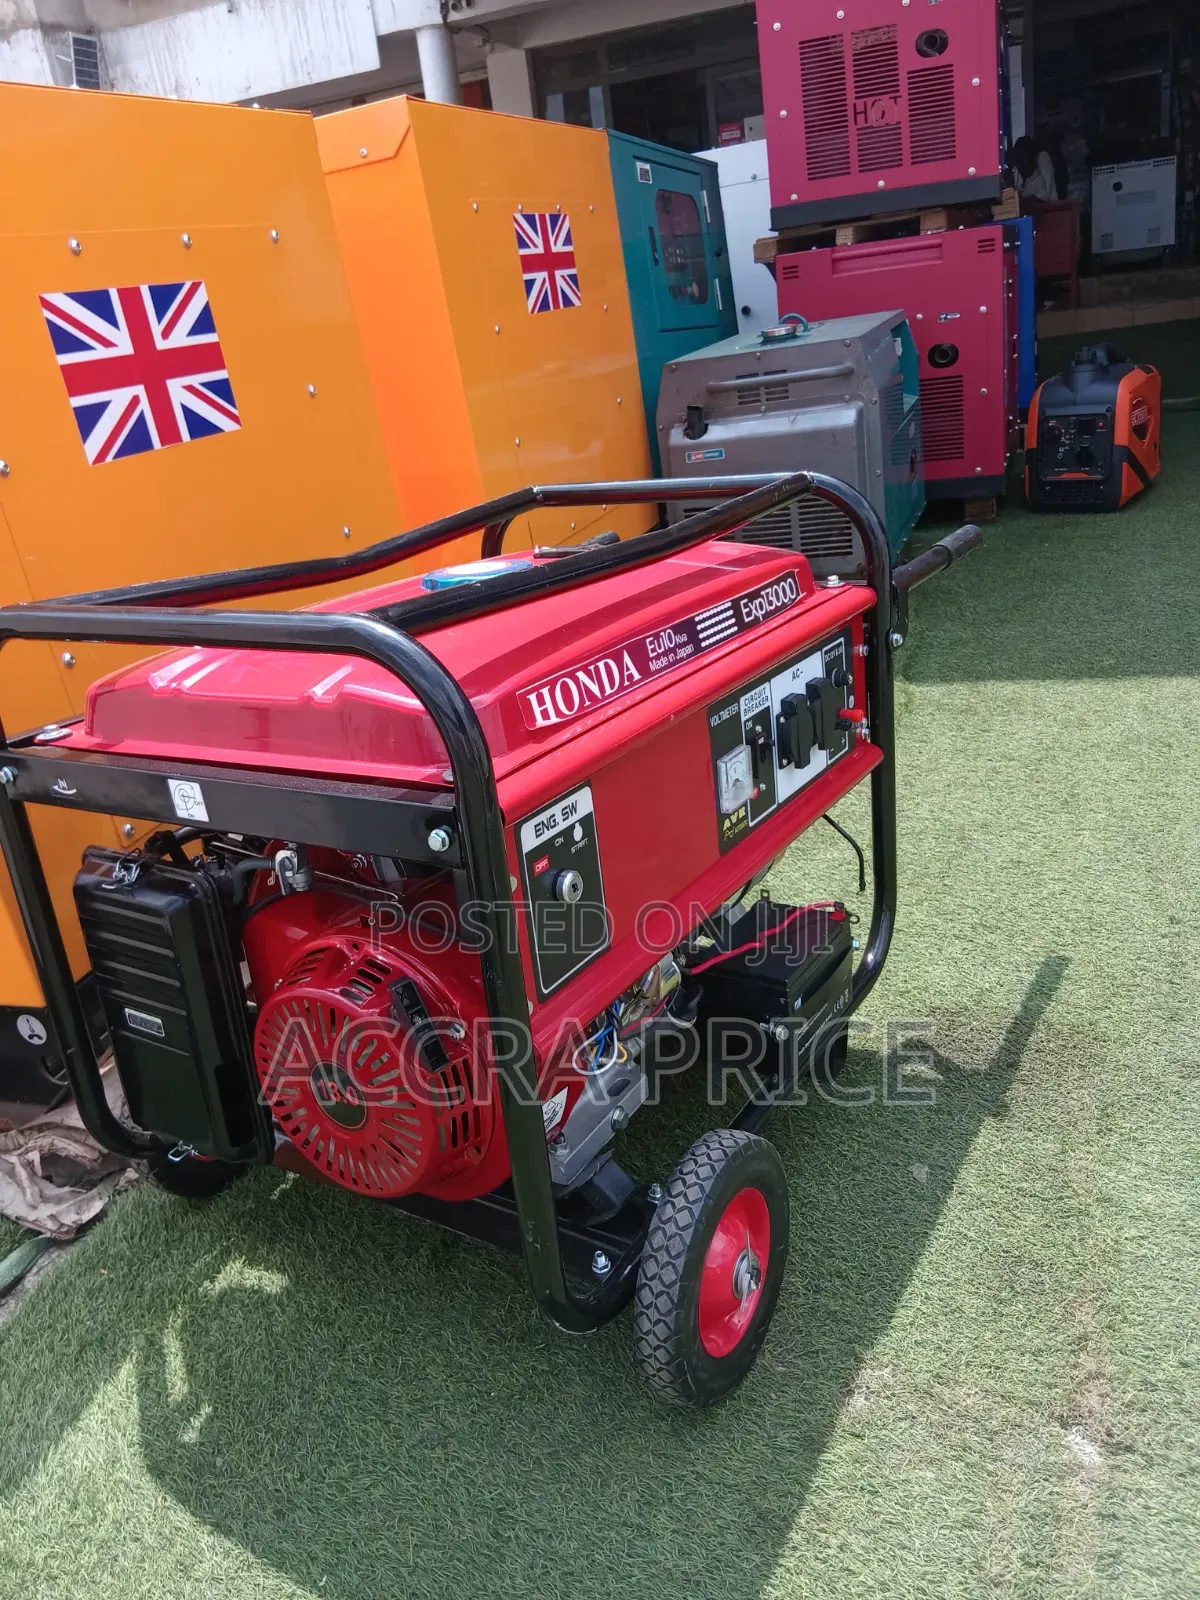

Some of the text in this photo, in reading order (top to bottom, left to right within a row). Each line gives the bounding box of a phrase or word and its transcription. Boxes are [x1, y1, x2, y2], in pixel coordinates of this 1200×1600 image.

[740, 578, 796, 623] Exp13000
[645, 629, 688, 657] Eu10 Kva
[649, 643, 695, 672] Made in Japan
[526, 649, 642, 725] HONDA
[744, 687, 766, 707] CIRCUIT
[709, 702, 739, 727] VOLTMETER
[744, 695, 769, 717] BREAKER
[745, 719, 753, 731] ON
[533, 799, 578, 839] ENG. SW
[723, 806, 746, 831] AVR
[554, 836, 564, 847] ON
[570, 838, 588, 854] START
[535, 858, 548, 872] OFF
